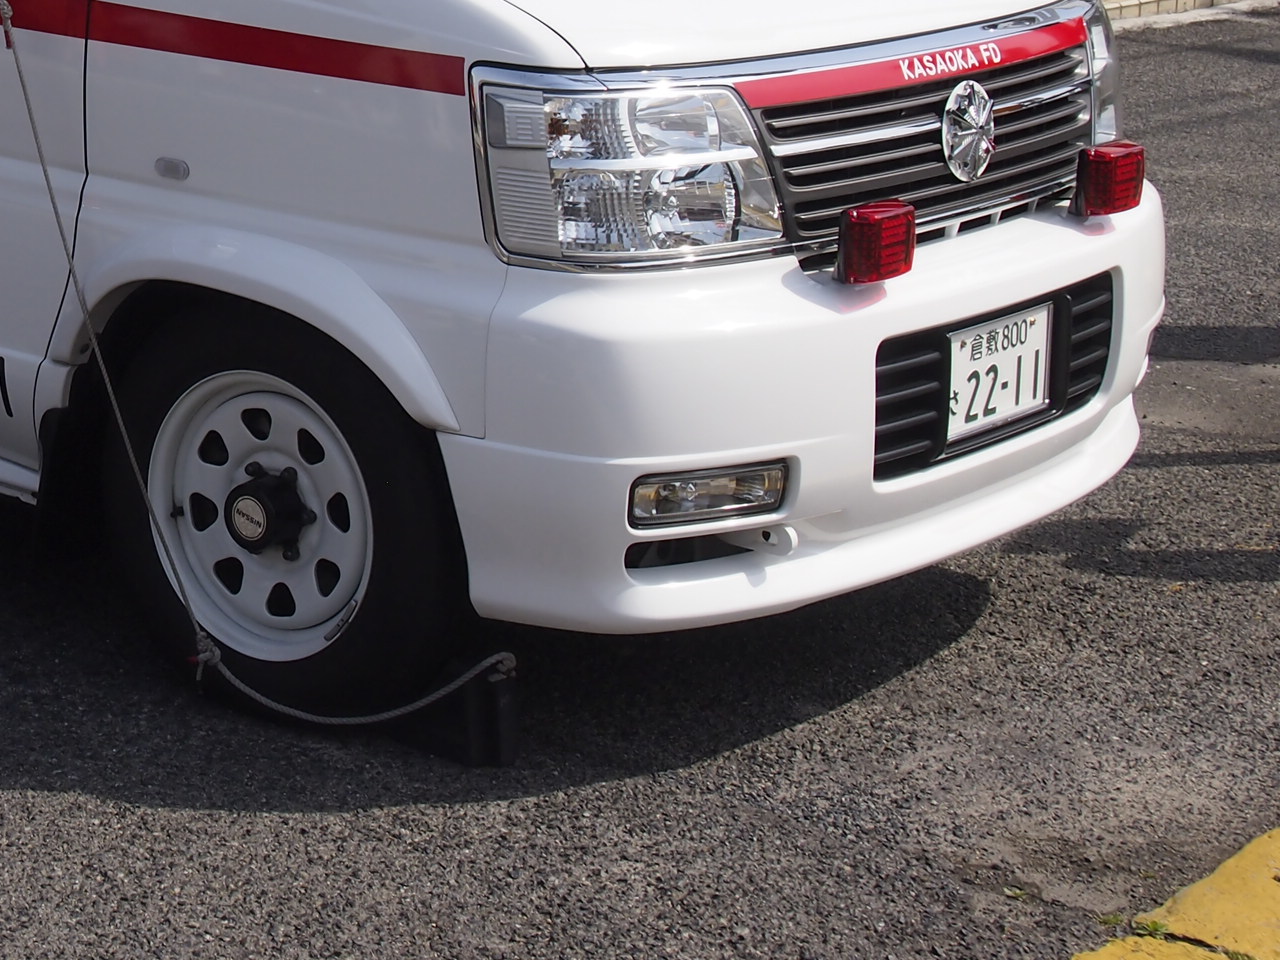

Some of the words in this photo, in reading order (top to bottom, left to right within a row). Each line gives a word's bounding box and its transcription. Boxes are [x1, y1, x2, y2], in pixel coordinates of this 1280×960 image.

[899, 47, 980, 80] KASAOKA
[979, 42, 1002, 65] FD
[964, 348, 1040, 424] 22-11
[236, 508, 262, 529] NISSAN
